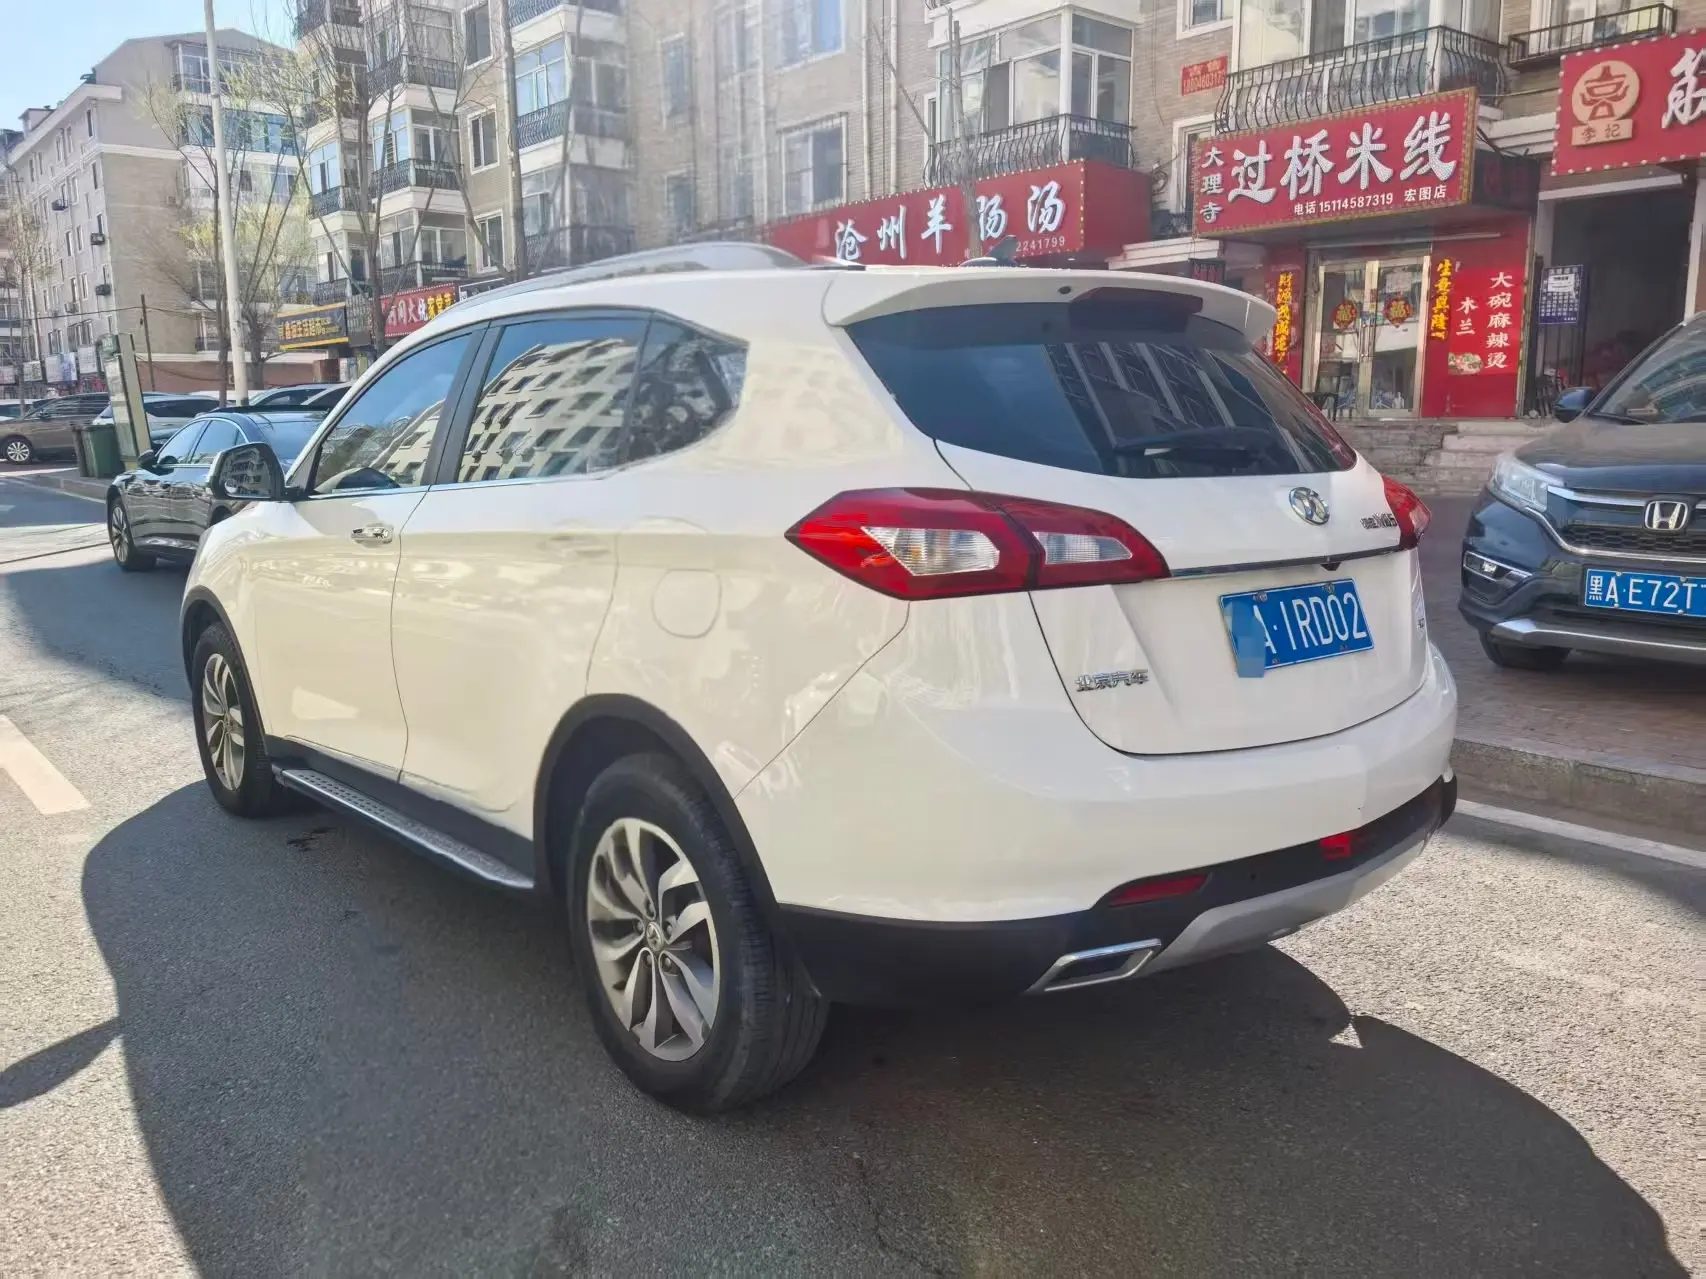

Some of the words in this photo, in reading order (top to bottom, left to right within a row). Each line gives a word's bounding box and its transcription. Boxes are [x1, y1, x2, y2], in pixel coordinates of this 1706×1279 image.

[1200, 146, 1225, 224] 大理寺
[1227, 111, 1456, 204] 过桥米线
[1293, 200, 1316, 215] 电话
[1319, 192, 1393, 213] 15114587319
[1404, 184, 1447, 202] 宏图店
[1456, 296, 1479, 336] 木兰
[1485, 271, 1514, 369] 大碗麻辣烫
[1588, 575, 1706, 609] 黑A·E72T
